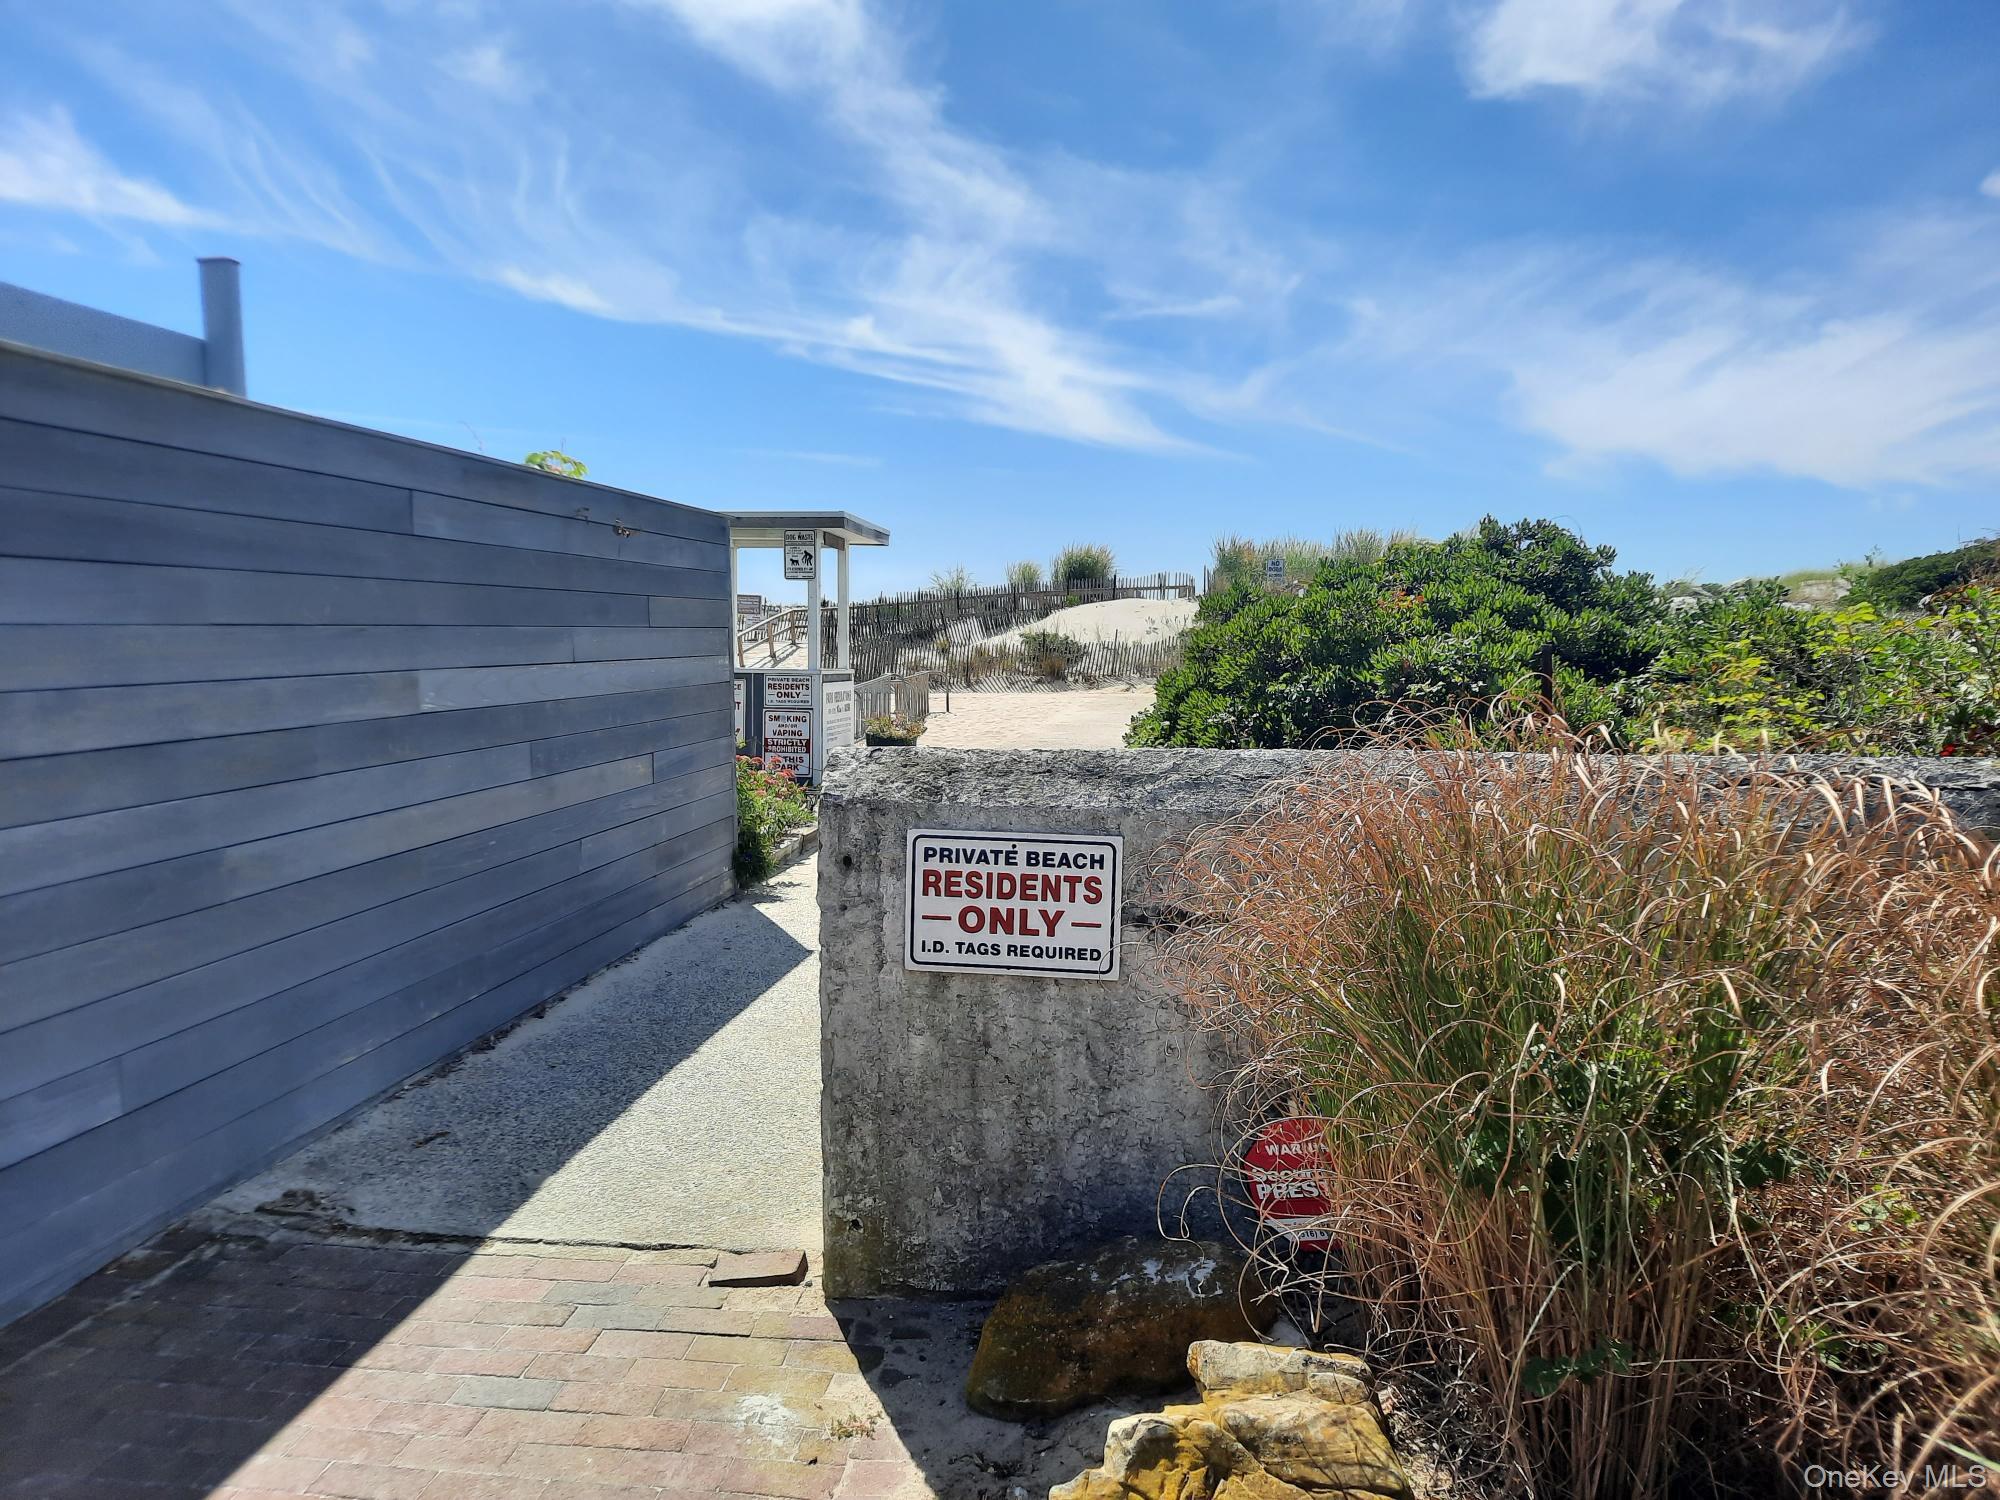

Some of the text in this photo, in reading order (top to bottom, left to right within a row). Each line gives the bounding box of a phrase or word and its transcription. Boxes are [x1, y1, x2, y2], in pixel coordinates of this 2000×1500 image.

[767, 683, 810, 691] RESIDENTS
[768, 715, 807, 723] SMKING
[772, 729, 803, 737] VAPING
[767, 738, 807, 746] STRICTLY
[923, 846, 1105, 870] PRIVATE BEACH
[922, 869, 1103, 905] RESIDENTS
[958, 905, 1065, 937] ONLY
[921, 940, 1102, 962] I.D. TAGS REQUIRED
